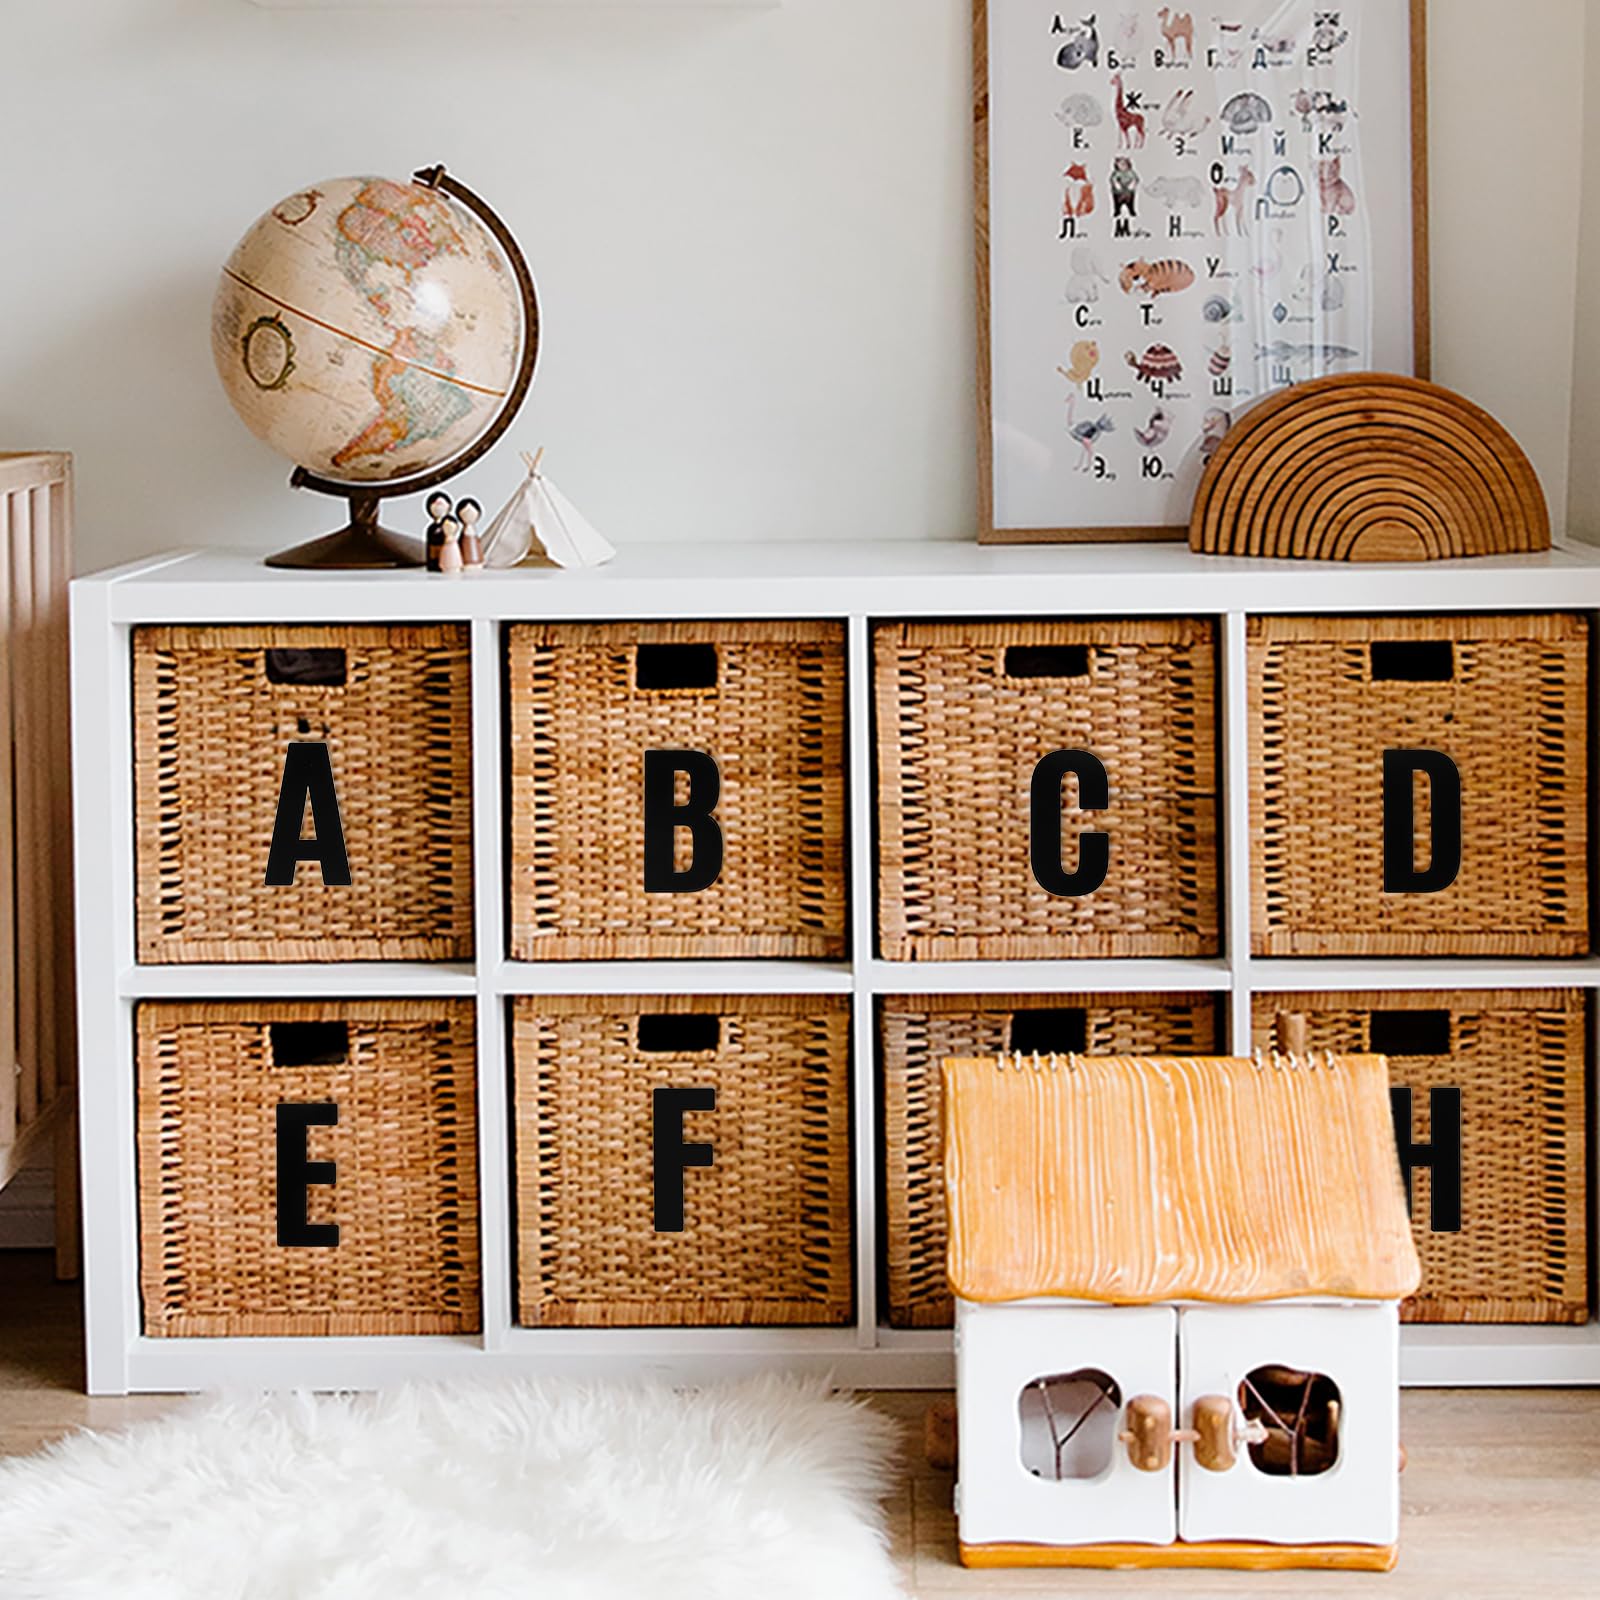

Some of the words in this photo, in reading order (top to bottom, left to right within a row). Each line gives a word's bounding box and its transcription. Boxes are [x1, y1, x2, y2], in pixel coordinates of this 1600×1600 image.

[1051, 14, 1063, 34] А
[1107, 50, 1119, 69] Б
[1319, 134, 1332, 154] К
[1211, 162, 1223, 184] О
[1059, 218, 1075, 239] Л
[1114, 219, 1131, 237] М
[1169, 215, 1181, 237] Н
[1328, 215, 1339, 236] Р
[1075, 305, 1089, 327] С
[1140, 304, 1153, 325] Т
[1087, 378, 1103, 402] Ц
[1213, 376, 1232, 396] Ш
[1142, 456, 1162, 477] Ю
[264, 742, 352, 886] A
[644, 749, 723, 893] B
[1030, 749, 1109, 897] C
[1383, 749, 1461, 893] D
[653, 1088, 716, 1232] F
[1391, 1087, 1461, 1232] H
[276, 1103, 339, 1248] E
